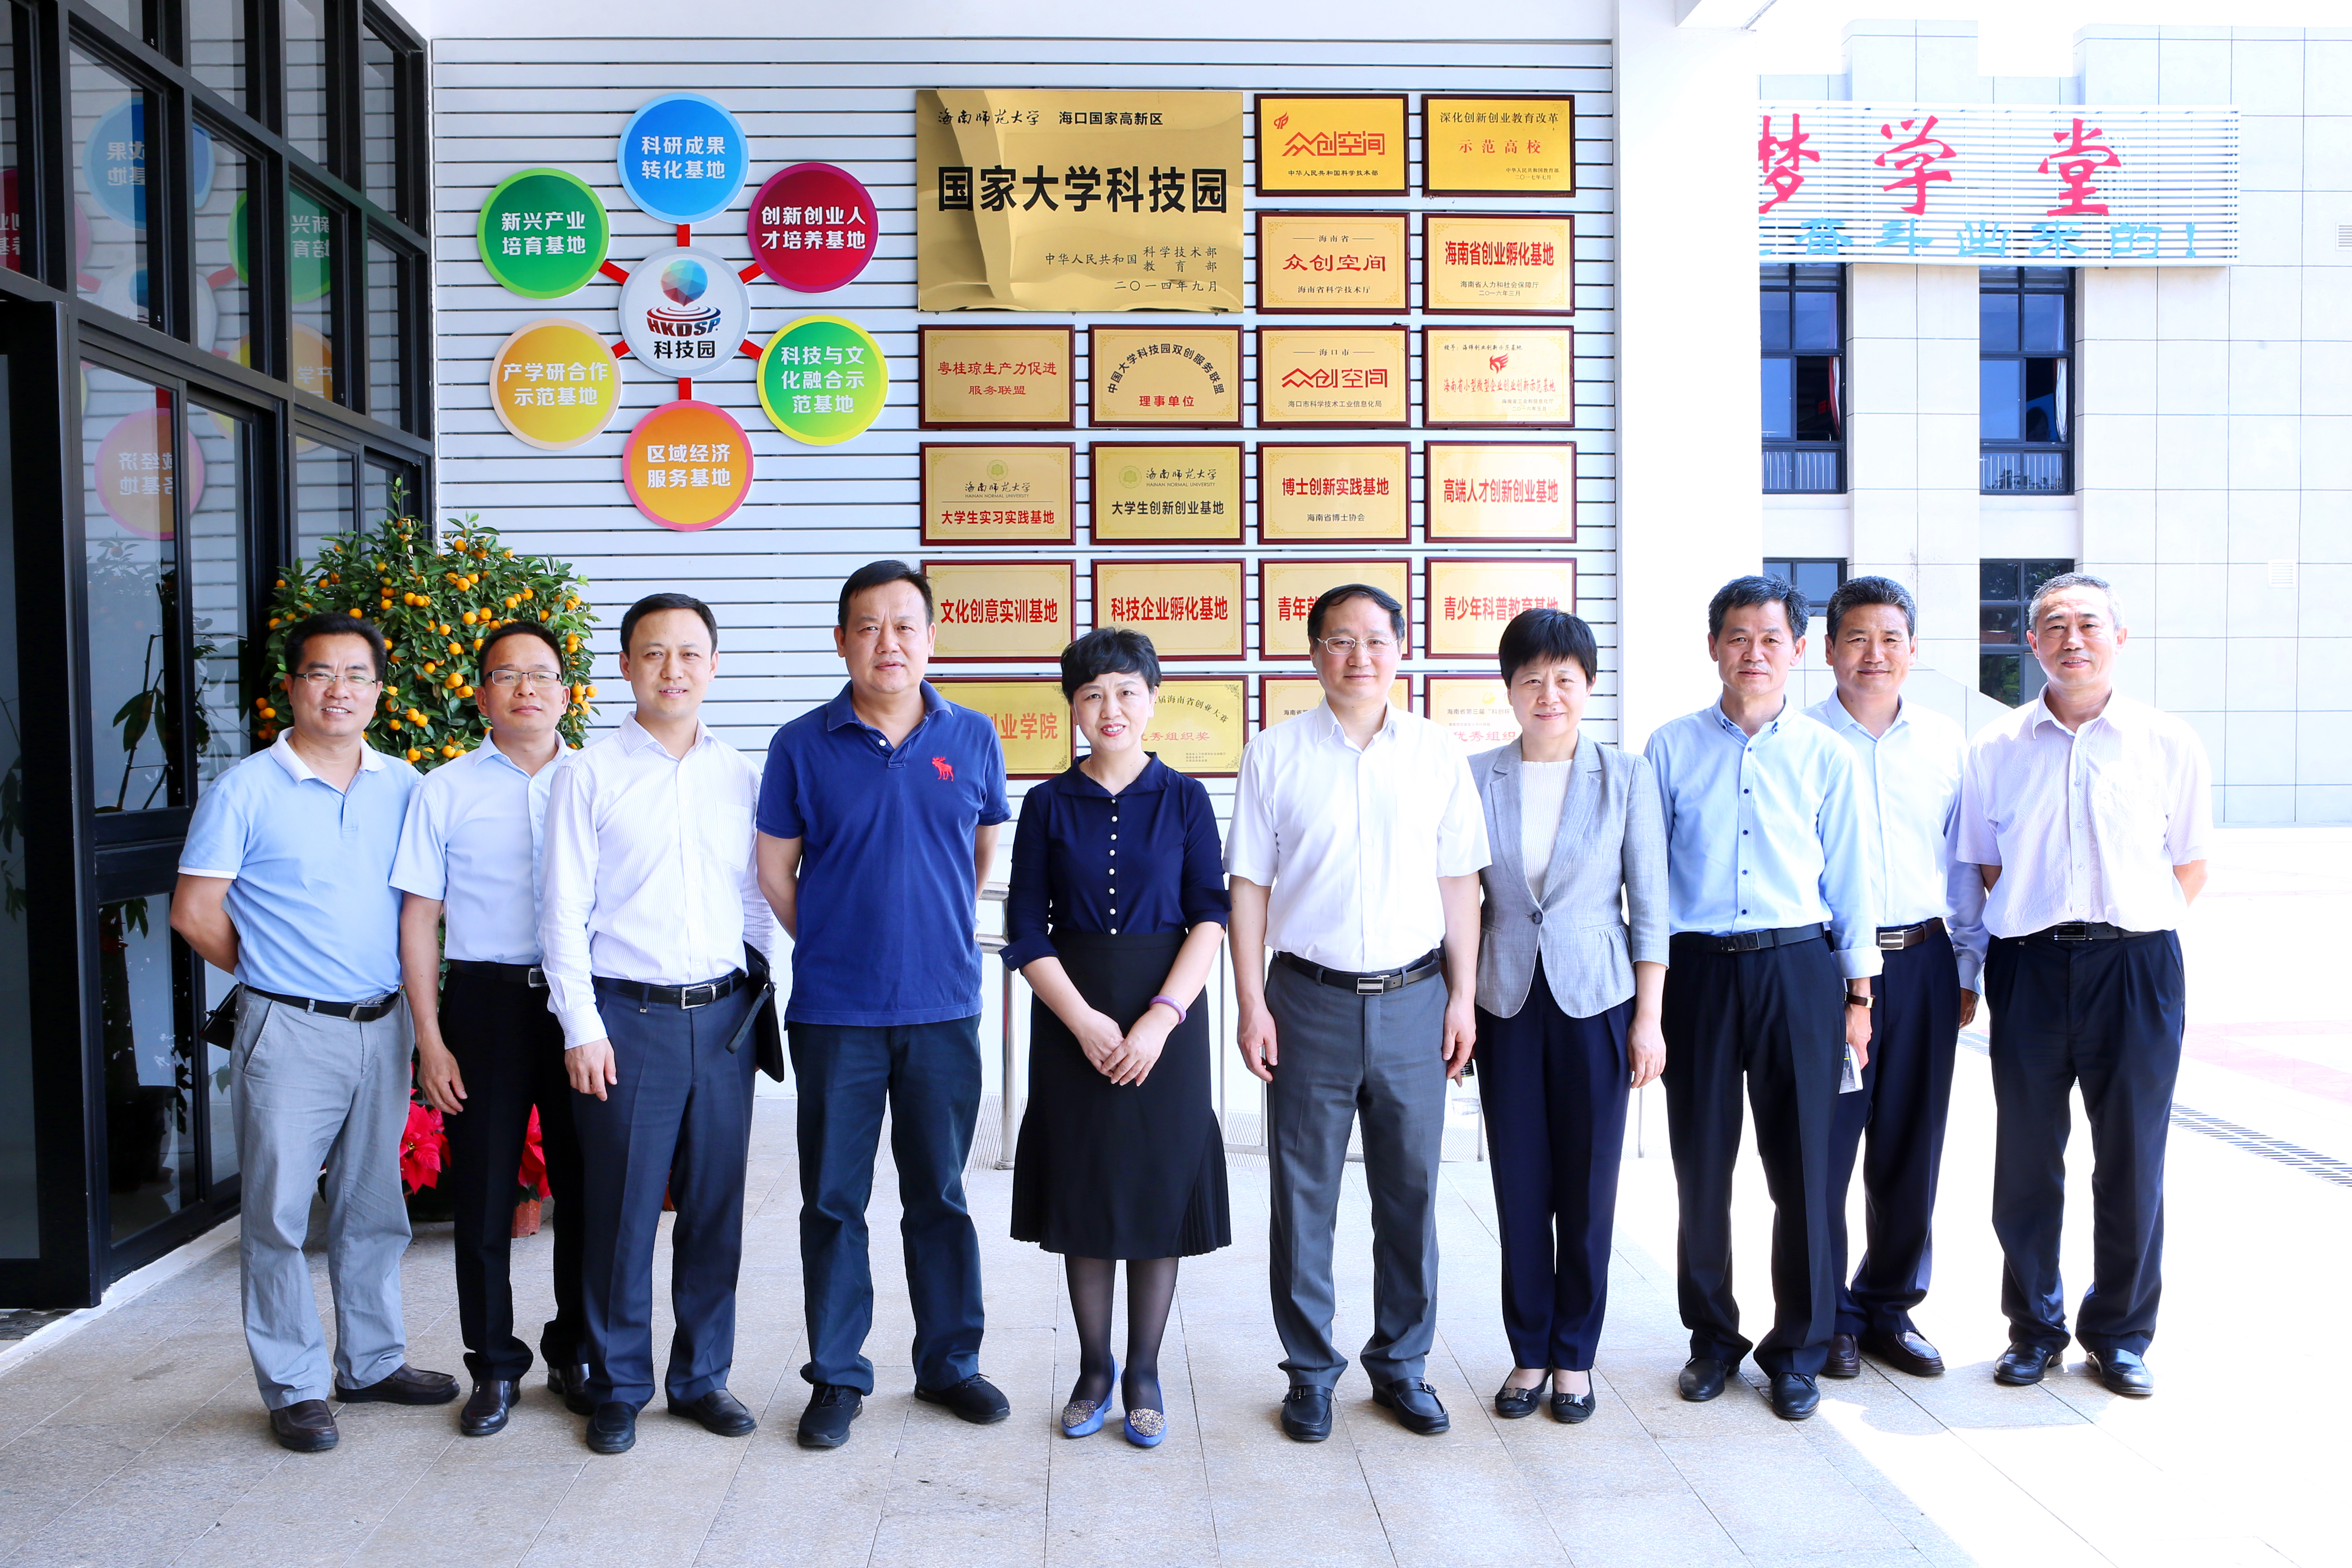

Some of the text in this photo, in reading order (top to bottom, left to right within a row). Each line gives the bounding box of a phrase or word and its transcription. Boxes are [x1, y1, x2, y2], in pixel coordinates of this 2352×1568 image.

[938, 108, 1163, 127] 海南师范大学 海口国家高新区
[1440, 112, 1559, 124] 深化创新创业教育改革
[641, 136, 726, 155] 科研成果
[1281, 131, 1385, 156] 众创空间
[1459, 139, 1541, 154] 示范高校
[641, 160, 726, 180] 转化基地
[1758, 113, 2122, 217] 梦学堂
[938, 165, 1227, 214] 国家大学科技园
[501, 211, 586, 231] 新兴产业
[761, 206, 866, 225] 创新创业人
[502, 235, 586, 255] 培育基地
[761, 230, 866, 250] 才培养基地
[1319, 235, 1349, 243] 海南省
[1045, 246, 1217, 265] 中华人民共和国 科学技术部
[1283, 253, 1386, 272] 众创空间
[1445, 241, 1554, 266] 海南省创业孵化基地
[1143, 260, 1217, 273] 教育部
[1298, 285, 1371, 294] 海南省科学技术厅
[654, 340, 715, 359] 科技园
[781, 346, 864, 365] 科技与文
[1319, 348, 1350, 357] 海口市
[504, 363, 608, 382] 产学研合作
[938, 362, 1057, 375] 粤桂琼生产力促进
[1107, 343, 1224, 395] 中国大学科技园双创服务联盟
[1282, 368, 1388, 388] 众创空间
[781, 371, 865, 390] 化融合示
[1444, 378, 1556, 393] 海南省小型微型企业创业创新示范基地
[514, 386, 598, 406] 示范基地
[968, 385, 1026, 396] 服务联盟
[792, 395, 854, 413] 范基地
[1139, 396, 1194, 407] 理事单位
[647, 444, 731, 463] 区域经济
[647, 469, 731, 488] 服务基地
[1146, 467, 1217, 480] 海南师范大学
[965, 482, 1031, 493] 海南师范大学
[1282, 477, 1389, 495] 博士创新实践基地
[1444, 478, 1558, 503] 高端人才创新创业基地
[941, 510, 1054, 524] 大学生实习实践基地
[1112, 501, 1224, 514] 大学生创新创业基地
[1307, 514, 1365, 522] 海南省博士协会
[941, 598, 1058, 623] 文化创意实训基地
[1111, 596, 1228, 622] 科技企业孵化基地
[1155, 695, 1229, 723] 届海南省创业大赛
